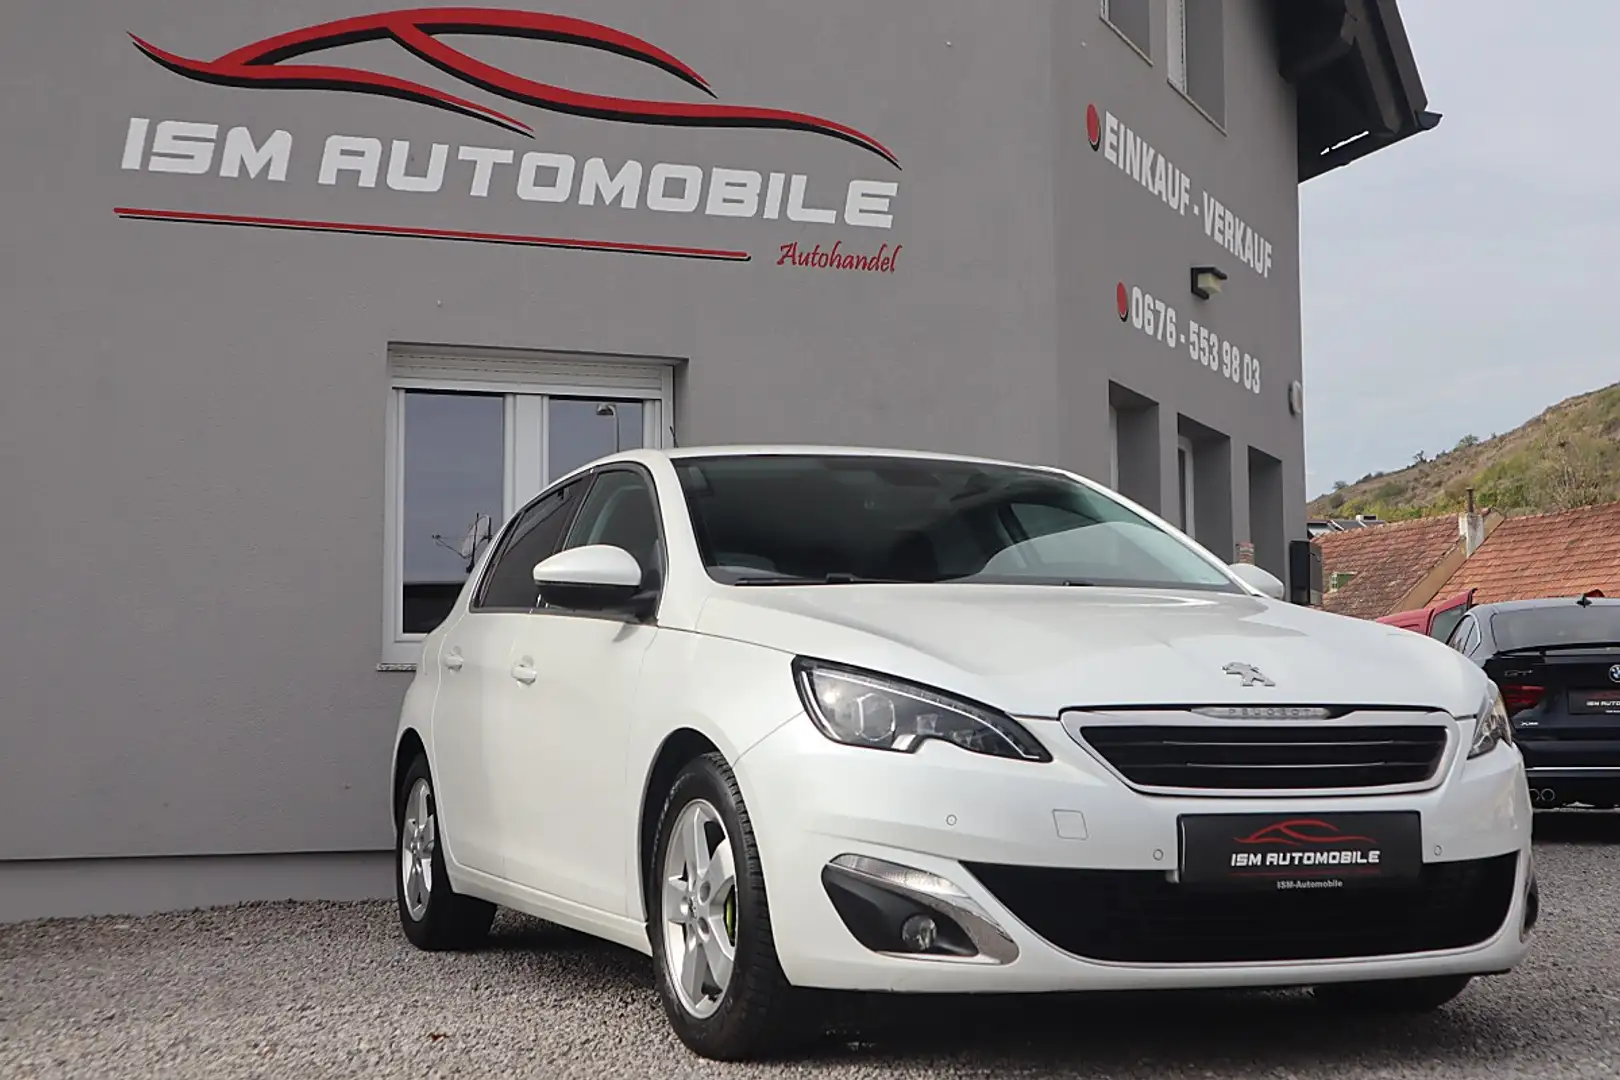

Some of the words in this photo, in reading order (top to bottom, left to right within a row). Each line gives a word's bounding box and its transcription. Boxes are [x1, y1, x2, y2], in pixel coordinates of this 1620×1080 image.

[121, 117, 293, 182] ISM
[317, 134, 899, 229] AUTOMOBILE
[1104, 111, 1190, 216] EINKAUF
[1202, 190, 1272, 278] VERKAUF
[776, 240, 902, 274] Autohandel
[1131, 285, 1177, 348] 0676
[1189, 319, 1219, 372] 553
[1222, 340, 1241, 384] 98
[1243, 352, 1261, 394] 03
[1231, 852, 1262, 867] ISM
[1266, 850, 1380, 866] AUTOMOBILE
[1276, 879, 1343, 890] ISM-Automobile
